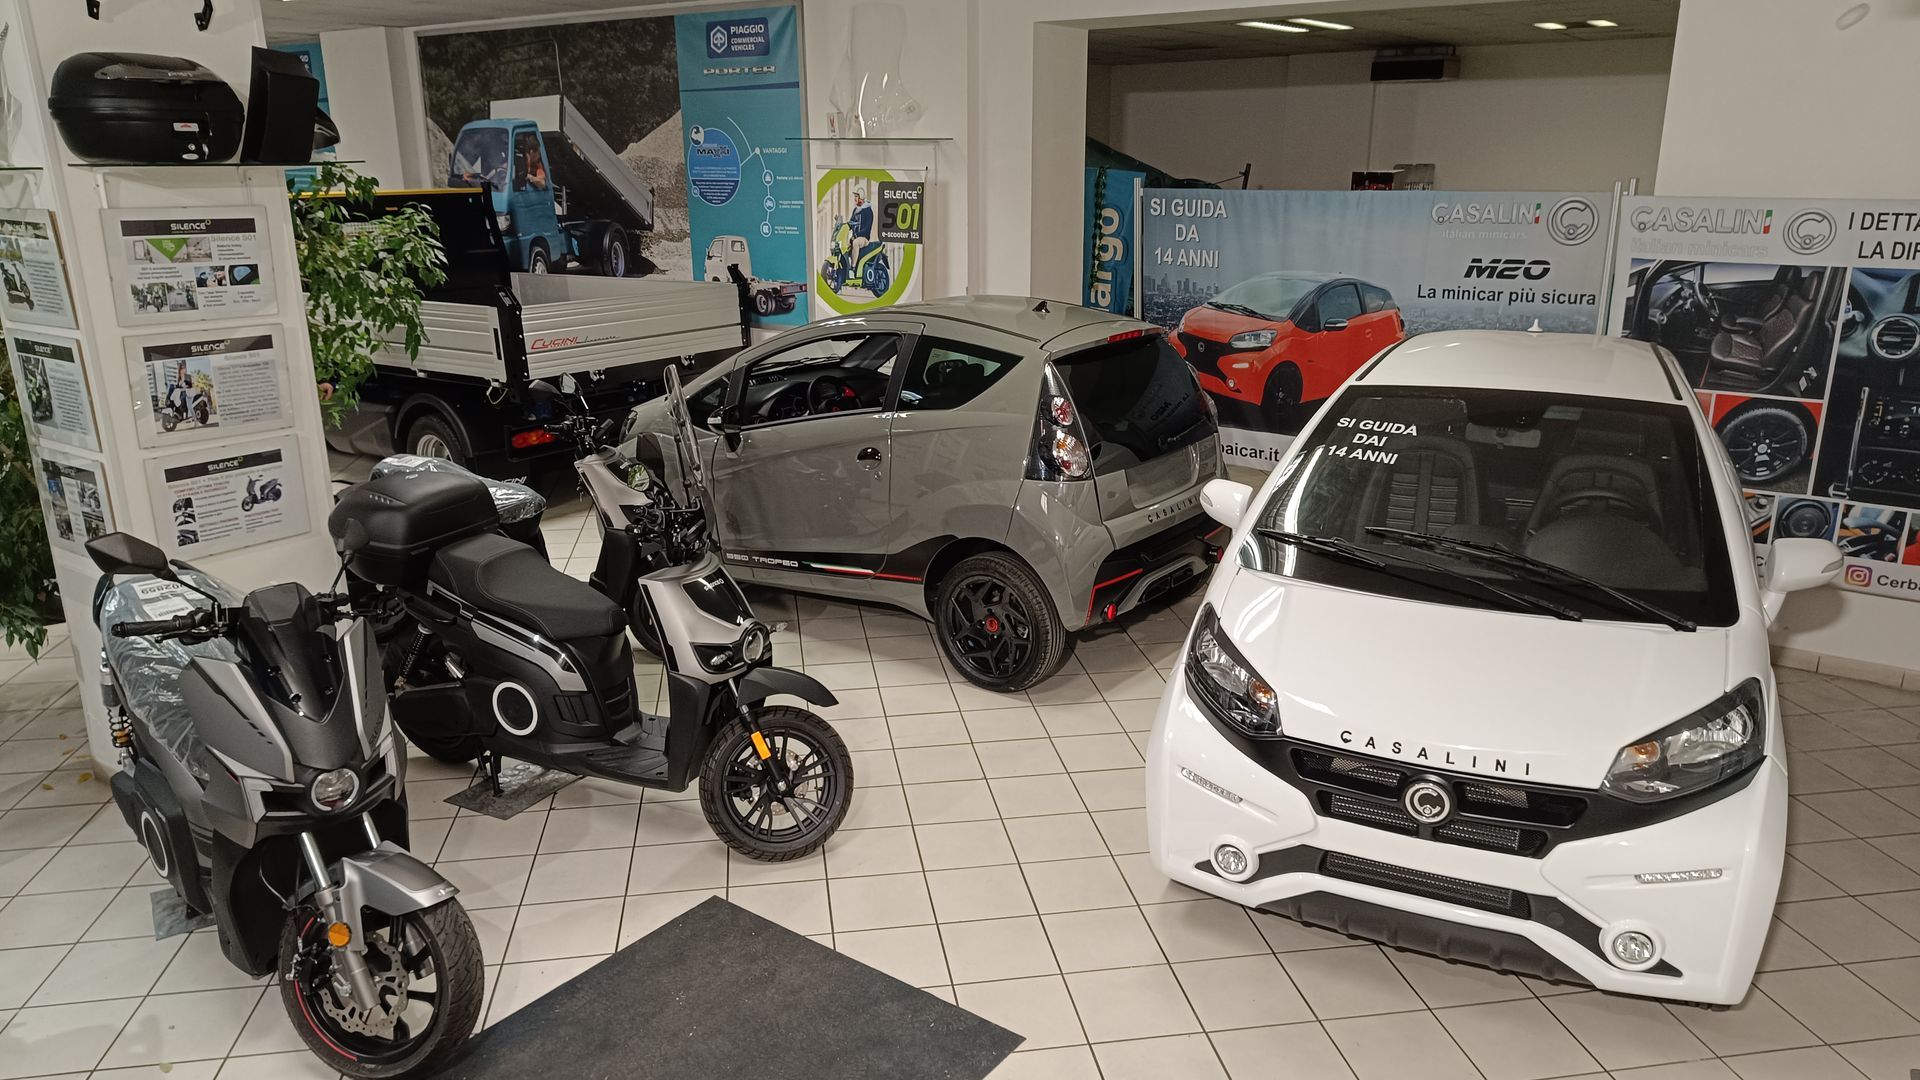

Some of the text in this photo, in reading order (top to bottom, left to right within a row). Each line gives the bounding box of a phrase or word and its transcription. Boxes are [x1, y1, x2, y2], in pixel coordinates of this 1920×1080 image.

[730, 24, 764, 35] PIAGGIO
[731, 36, 765, 45] COMMERCIAL
[731, 44, 755, 52] VEHICLES
[703, 65, 776, 76] PORTER
[882, 202, 921, 231] S01
[1150, 198, 1228, 218] SI GUIDA
[1848, 211, 1855, 231] I
[881, 231, 910, 239] e-scooter
[1175, 224, 1200, 242] DA
[1090, 207, 1124, 311] argo
[1154, 247, 1219, 268] 14 ANNI
[1857, 240, 1885, 259] LA
[1463, 258, 1551, 280] M20
[1417, 284, 1597, 306] La minicar più sicura
[1337, 417, 1418, 437] SI GUIDA
[1352, 433, 1388, 447] DAI
[1327, 445, 1399, 465] 14 ANNI
[1147, 495, 1199, 523] CASALINI
[1877, 574, 1920, 591] Cerb
[1340, 730, 1530, 776] CASALINI
